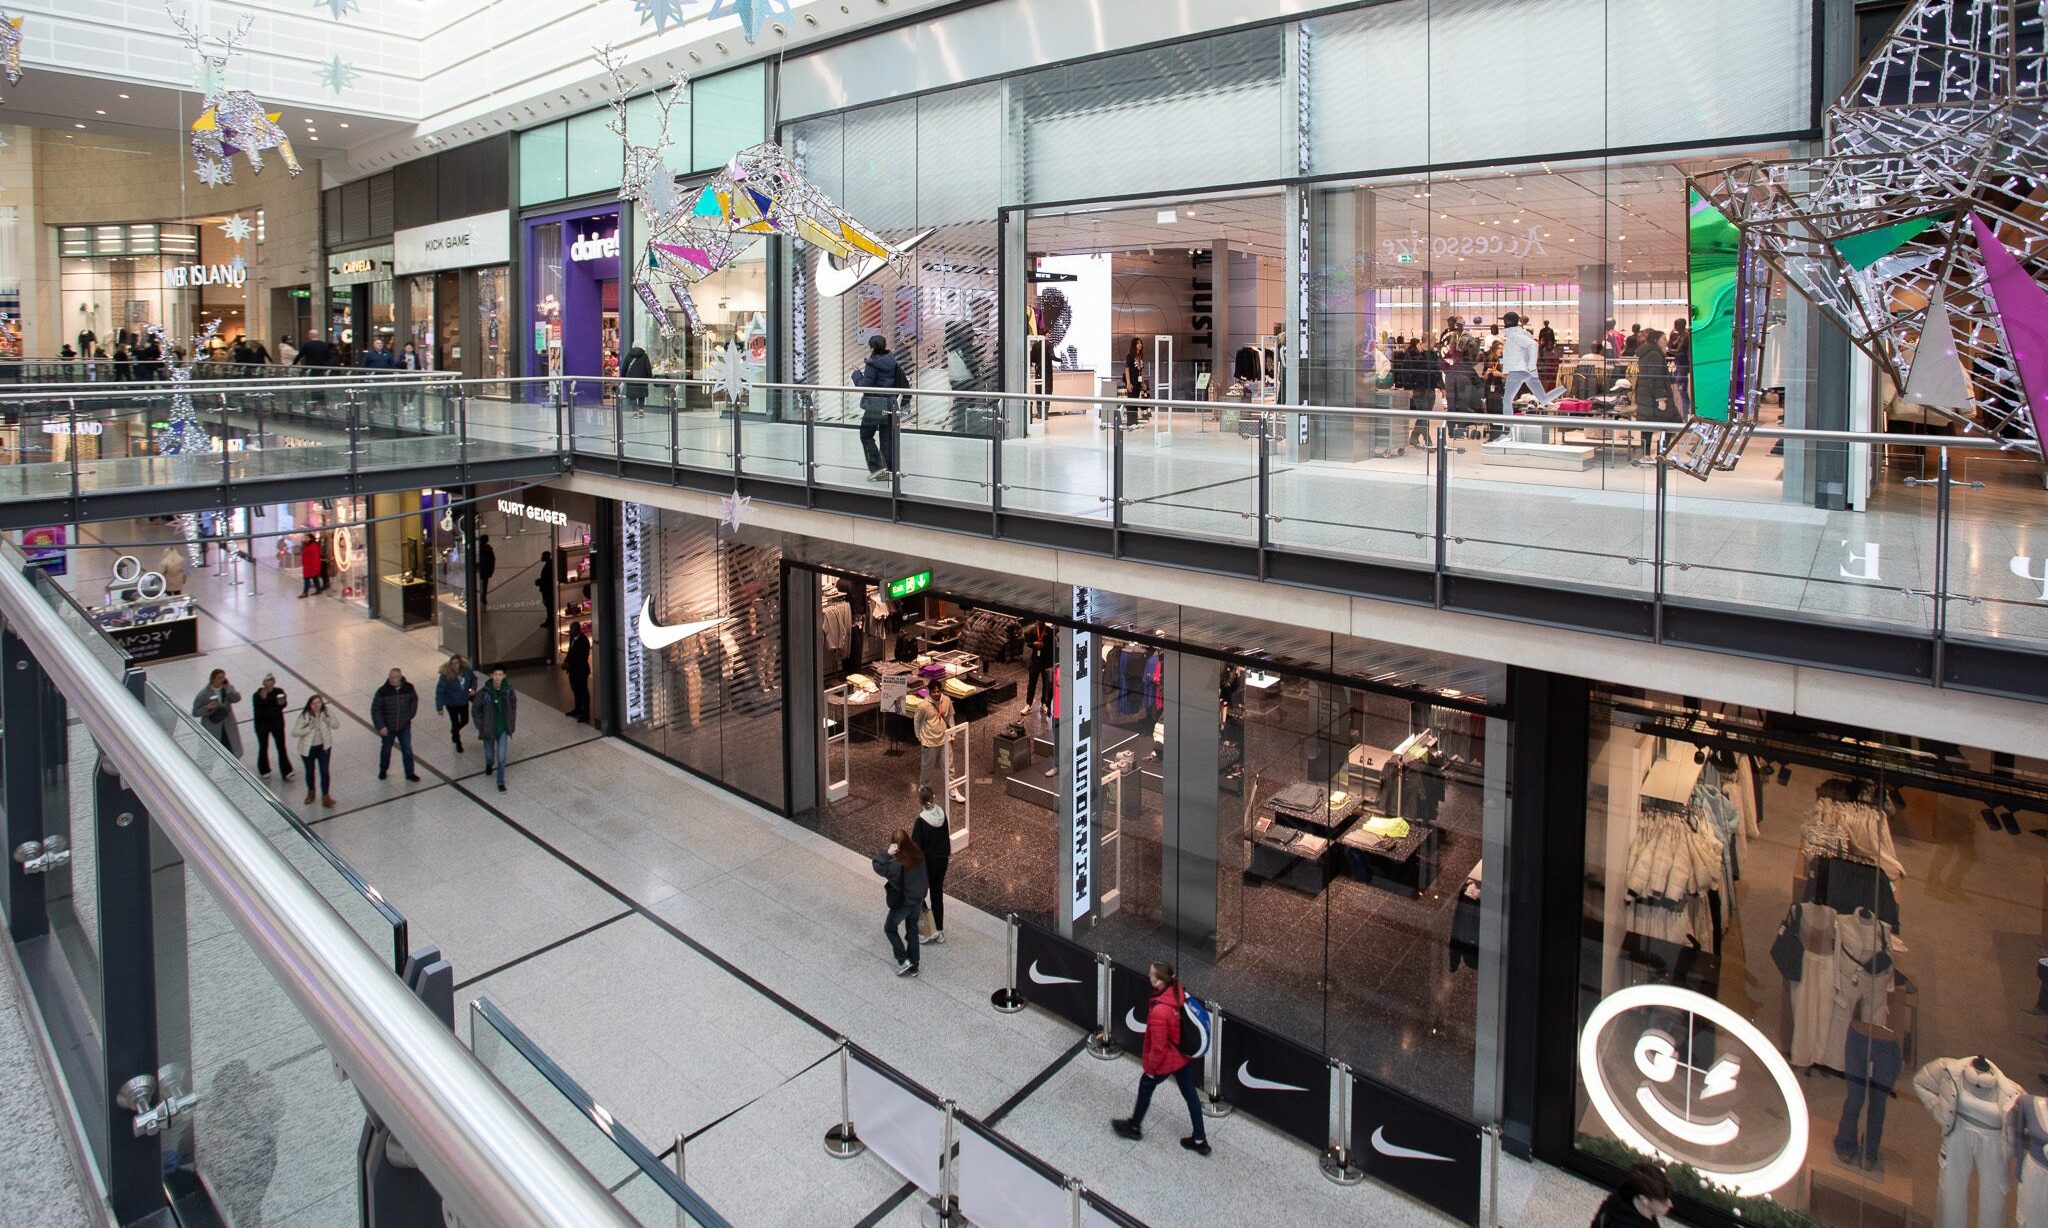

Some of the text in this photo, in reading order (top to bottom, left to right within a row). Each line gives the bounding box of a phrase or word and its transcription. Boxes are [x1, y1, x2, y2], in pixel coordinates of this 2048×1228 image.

[425, 233, 470, 251] KICK GAME
[190, 264, 247, 285] ISLAND
[497, 499, 568, 527] KURT GEIGER
[486, 602, 511, 610] KURT
